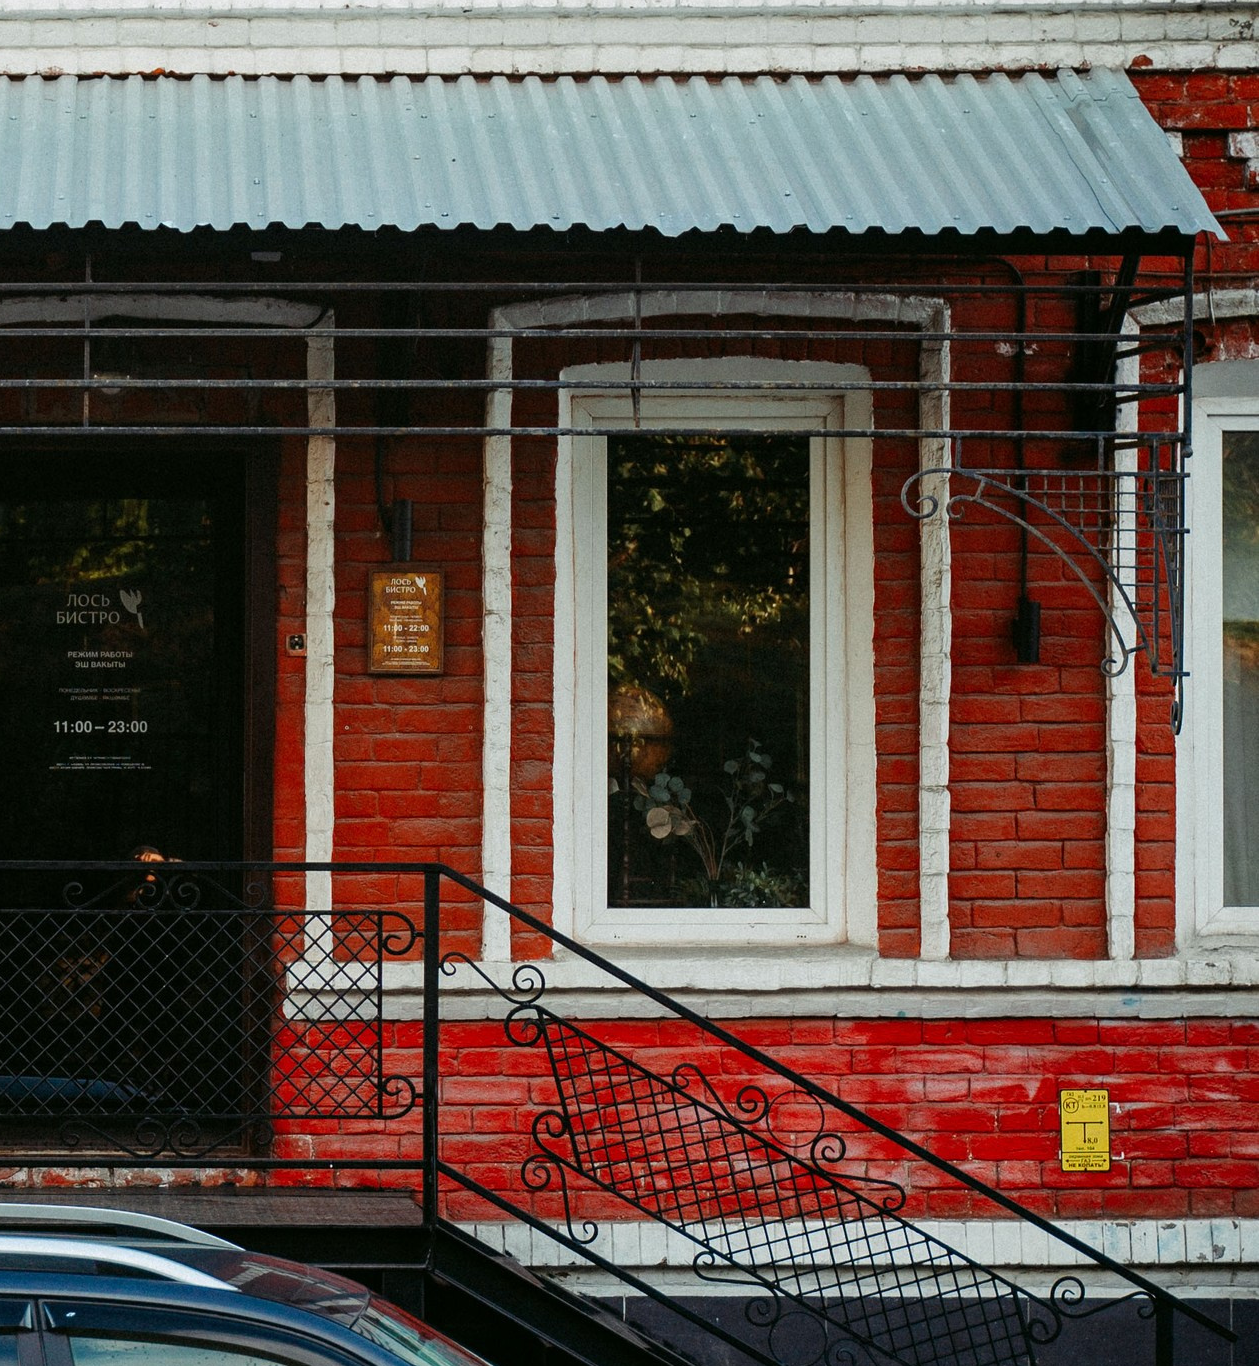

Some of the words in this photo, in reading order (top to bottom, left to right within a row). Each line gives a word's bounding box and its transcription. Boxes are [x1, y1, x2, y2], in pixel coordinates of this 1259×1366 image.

[390, 578, 412, 586] ЛОСЬ
[385, 586, 416, 594] БИСТРО
[66, 593, 111, 607] ЛОСЬ
[56, 611, 120, 625] БИСТРО
[383, 624, 403, 632] 11:00
[408, 624, 430, 632] 22:00
[383, 645, 403, 653] 11:00
[408, 645, 430, 653] 23:00
[53, 720, 92, 734] 11:00
[107, 720, 148, 734] 23:00
